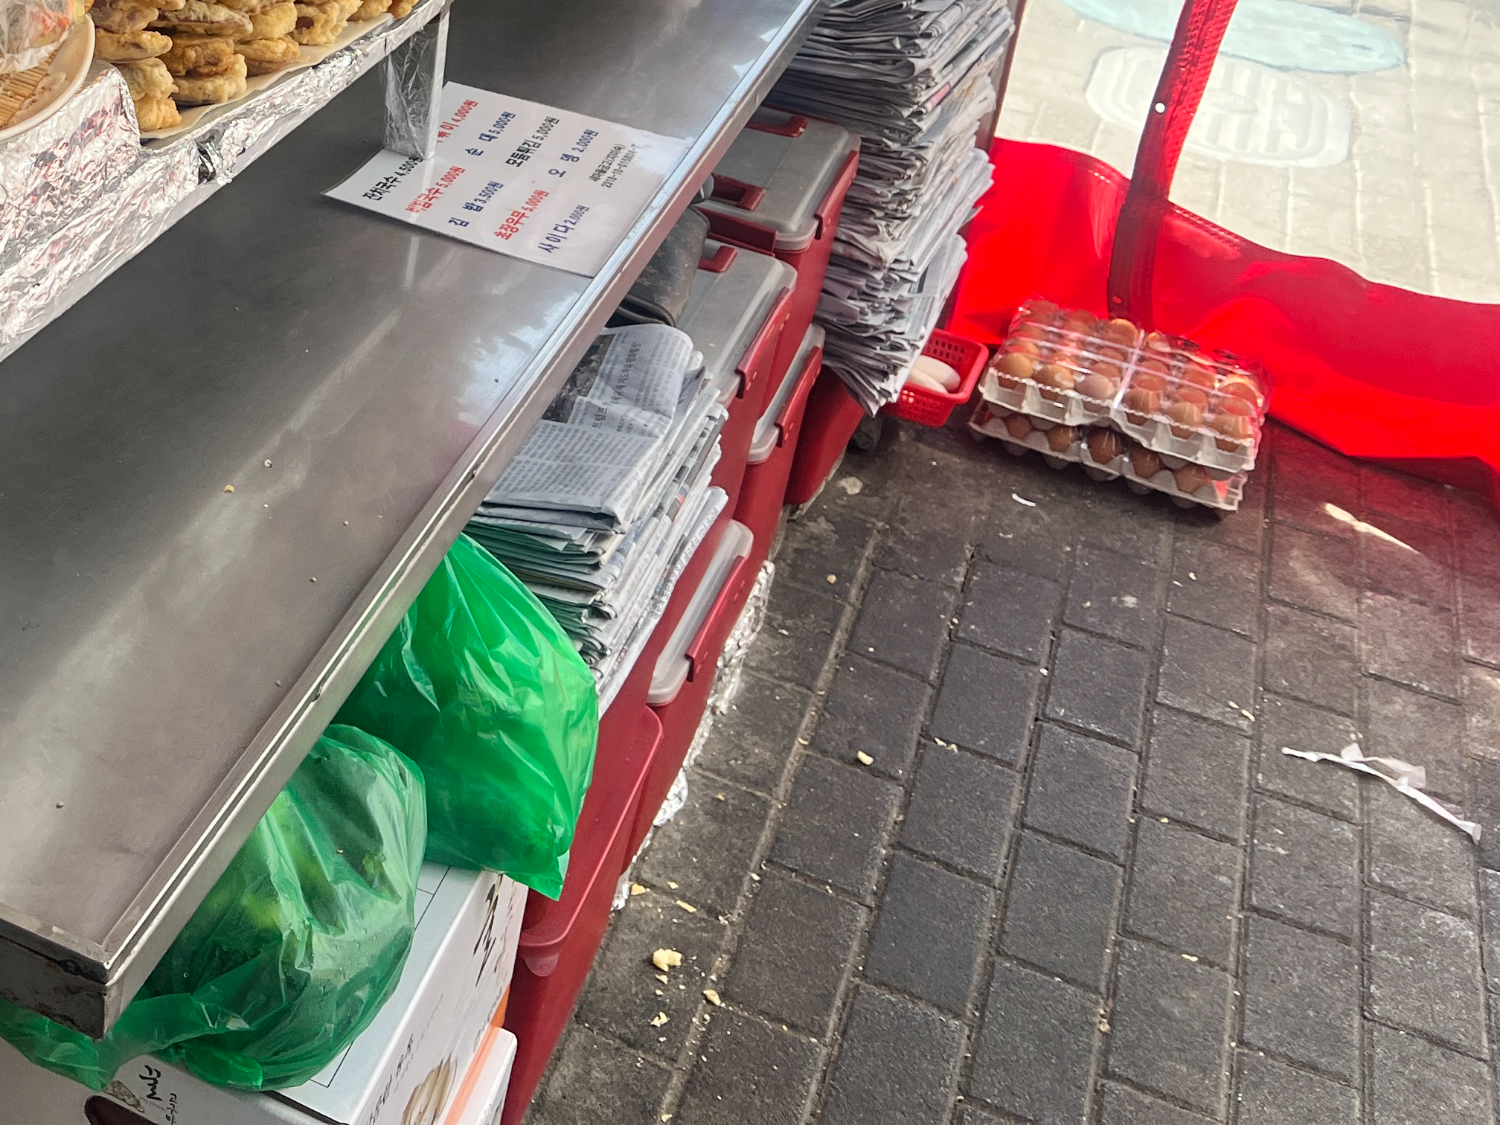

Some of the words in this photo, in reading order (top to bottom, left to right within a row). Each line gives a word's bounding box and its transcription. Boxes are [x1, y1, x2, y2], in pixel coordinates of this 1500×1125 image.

[437, 121, 459, 143] 볶이
[451, 99, 479, 121] 4,000원
[488, 111, 516, 135] 5,000원
[505, 139, 542, 168] 모듬튀김
[532, 116, 560, 142] 5,000원
[571, 129, 599, 153] 2,000원
[362, 175, 402, 201] 잔치국수
[394, 156, 424, 176] 4,500원
[405, 187, 444, 214] 비빔국수
[435, 166, 466, 188] 5,000원
[473, 181, 504, 204] 3,500원
[521, 189, 550, 212] 5,000원
[538, 223, 575, 254] 사이다
[563, 204, 590, 227] 2,000원
